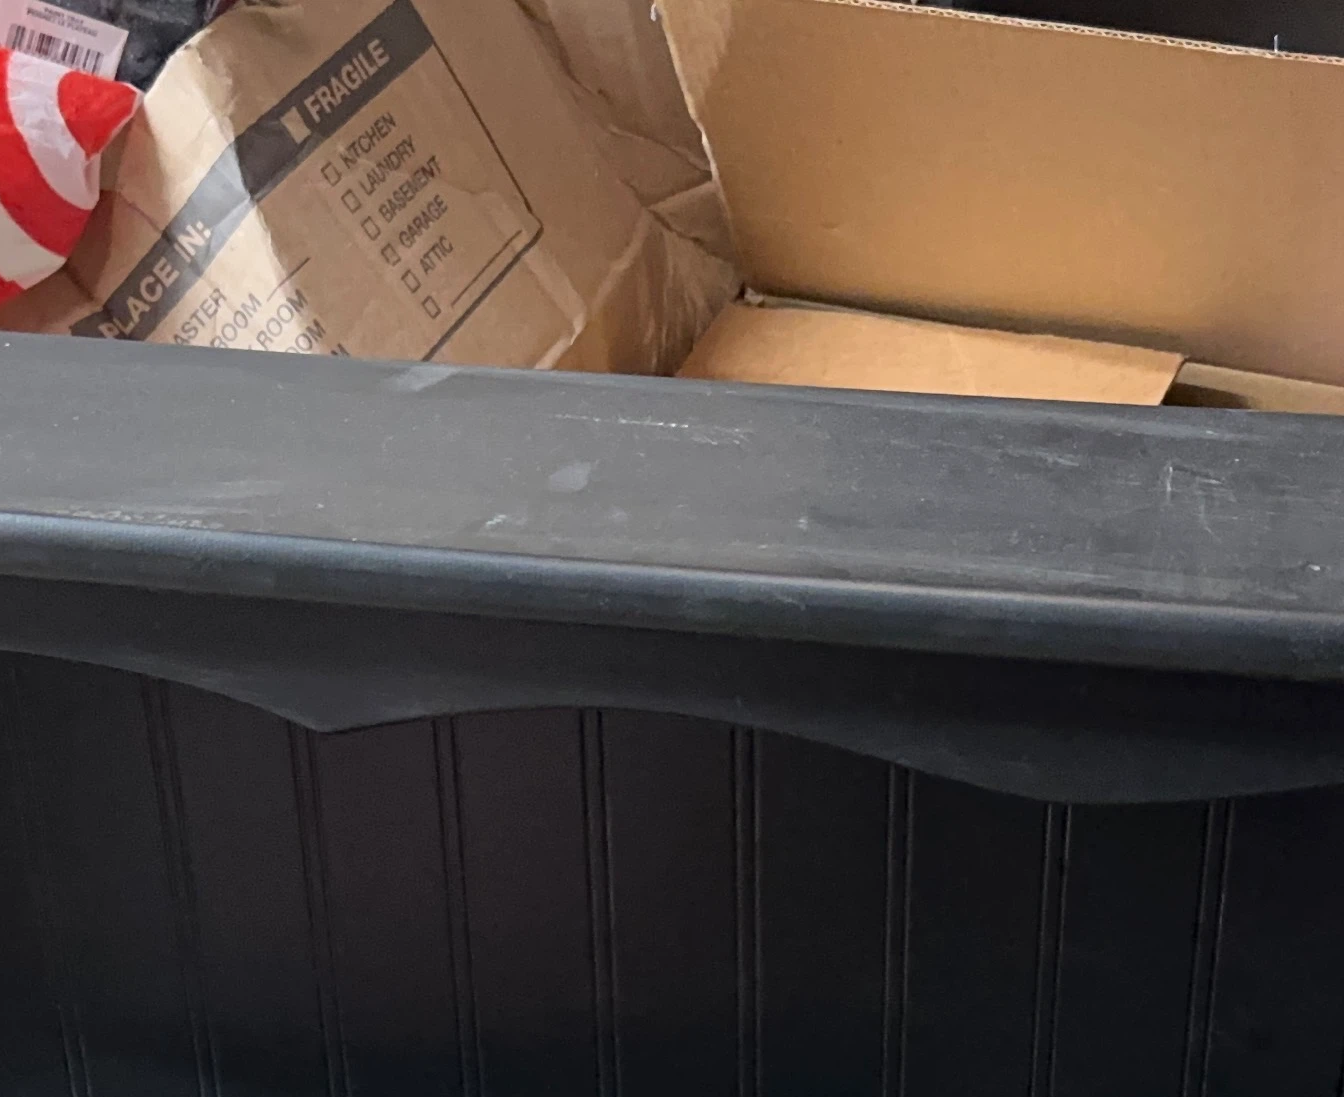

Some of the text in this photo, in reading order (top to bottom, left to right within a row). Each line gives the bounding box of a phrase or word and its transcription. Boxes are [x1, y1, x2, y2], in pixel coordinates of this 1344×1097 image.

[303, 38, 390, 124] FRAGILE
[339, 112, 397, 170] KITCHEN
[359, 134, 416, 196] LAUNDRY
[378, 154, 442, 224] BASEMENT
[398, 194, 449, 249] GARAGE
[97, 220, 212, 339] PLACE IN:
[419, 235, 454, 275] ATTIC
[172, 287, 228, 347] ASTER
[210, 292, 263, 349] ROOM
[286, 318, 327, 355] OOM
